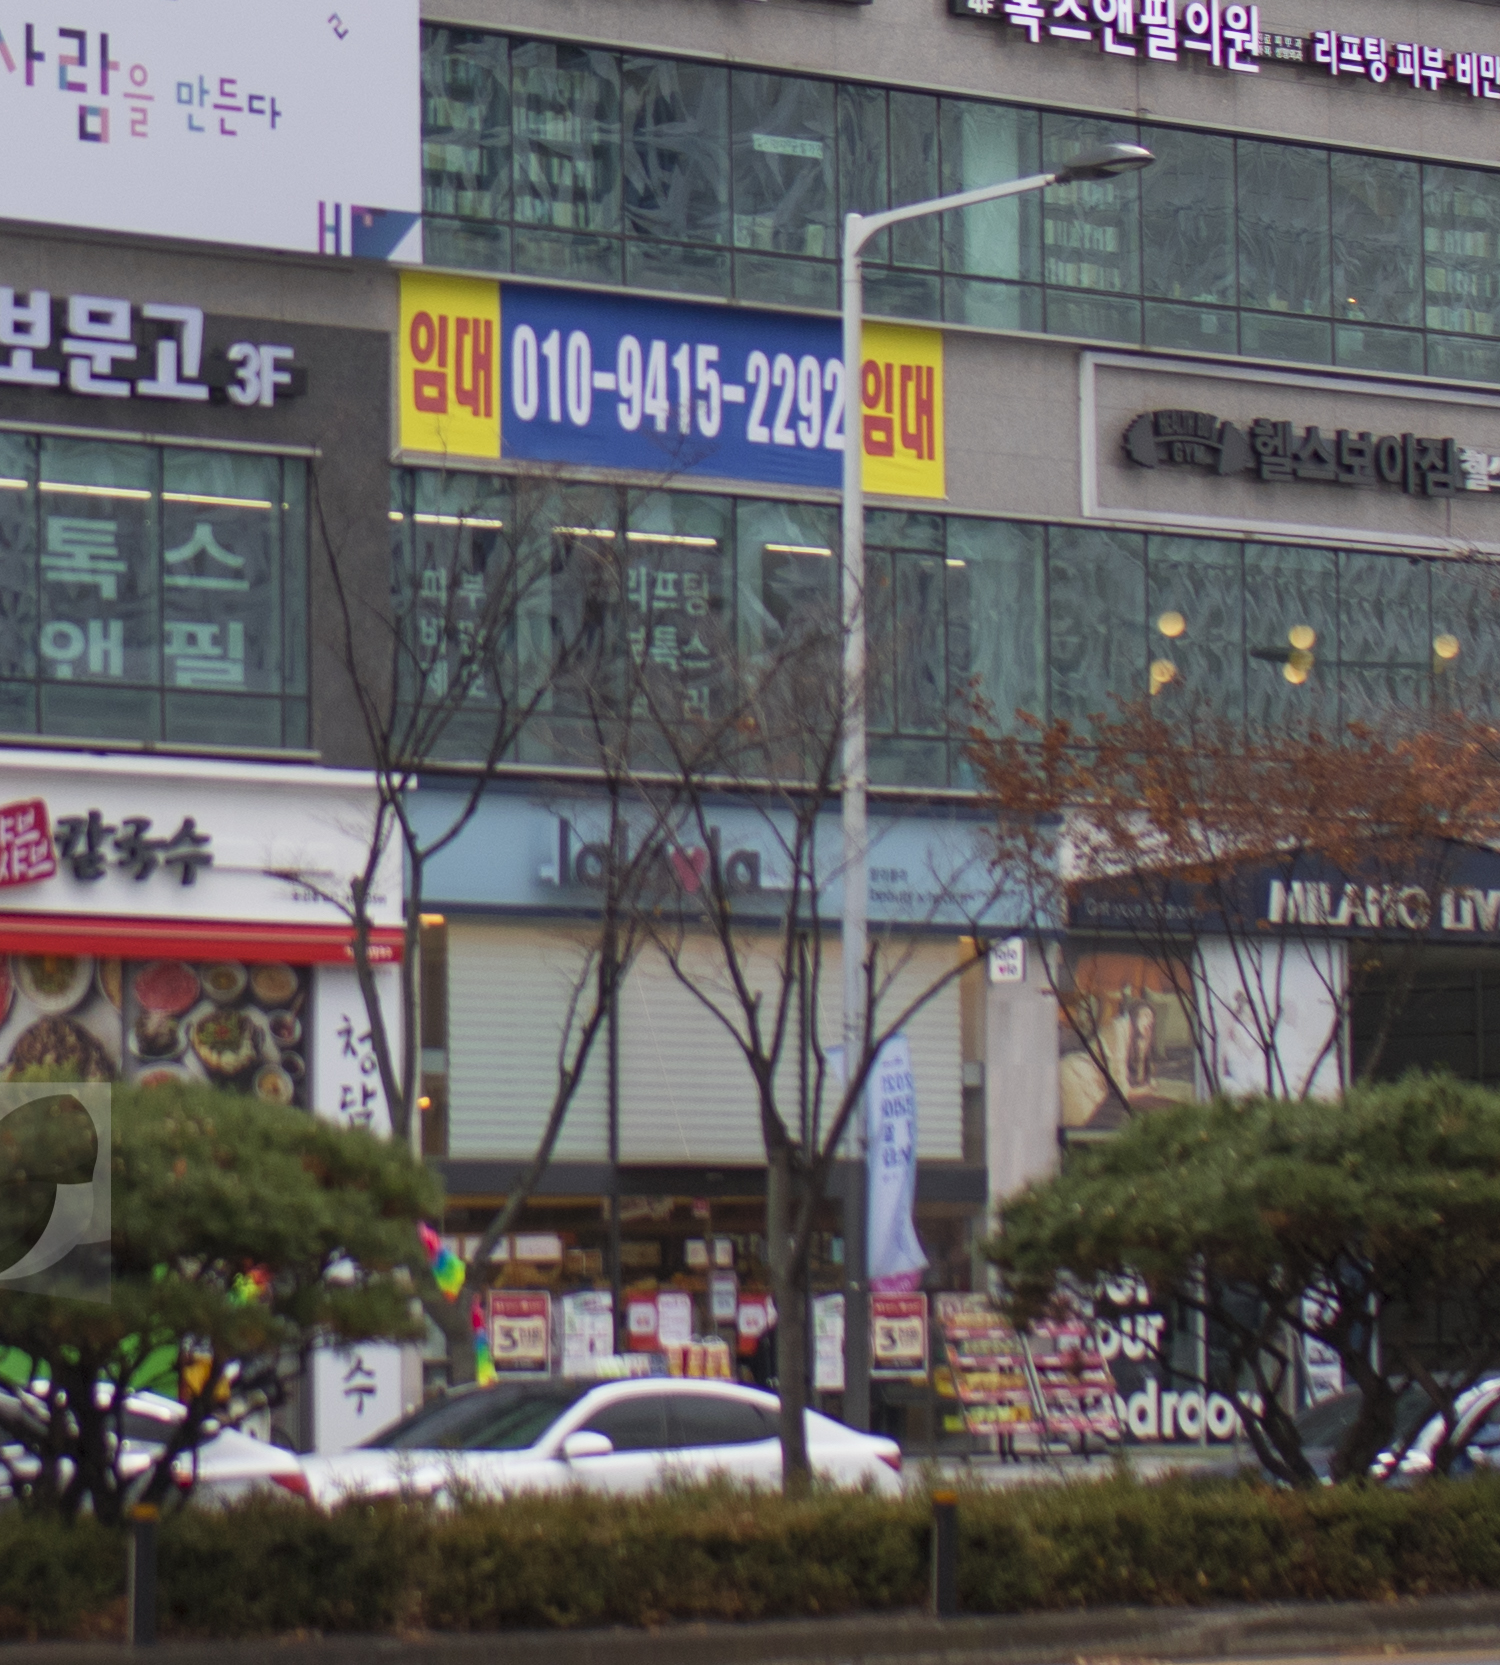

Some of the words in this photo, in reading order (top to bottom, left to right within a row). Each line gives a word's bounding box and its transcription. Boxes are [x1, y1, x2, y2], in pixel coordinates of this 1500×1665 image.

[1310, 29, 1389, 84] 리프팅
[1394, 42, 1448, 91] 피부
[175, 74, 284, 138] 만든다
[226, 341, 296, 410] 3F
[406, 306, 496, 421] 임대
[509, 320, 847, 453] 010-9415-2292
[860, 359, 938, 464] 임대
[1254, 417, 1458, 497] 헬스보이짐
[42, 514, 251, 603] 톡스
[39, 614, 249, 692] 앤필
[55, 805, 214, 886] 칼국수
[1268, 879, 1433, 929] MILANO
